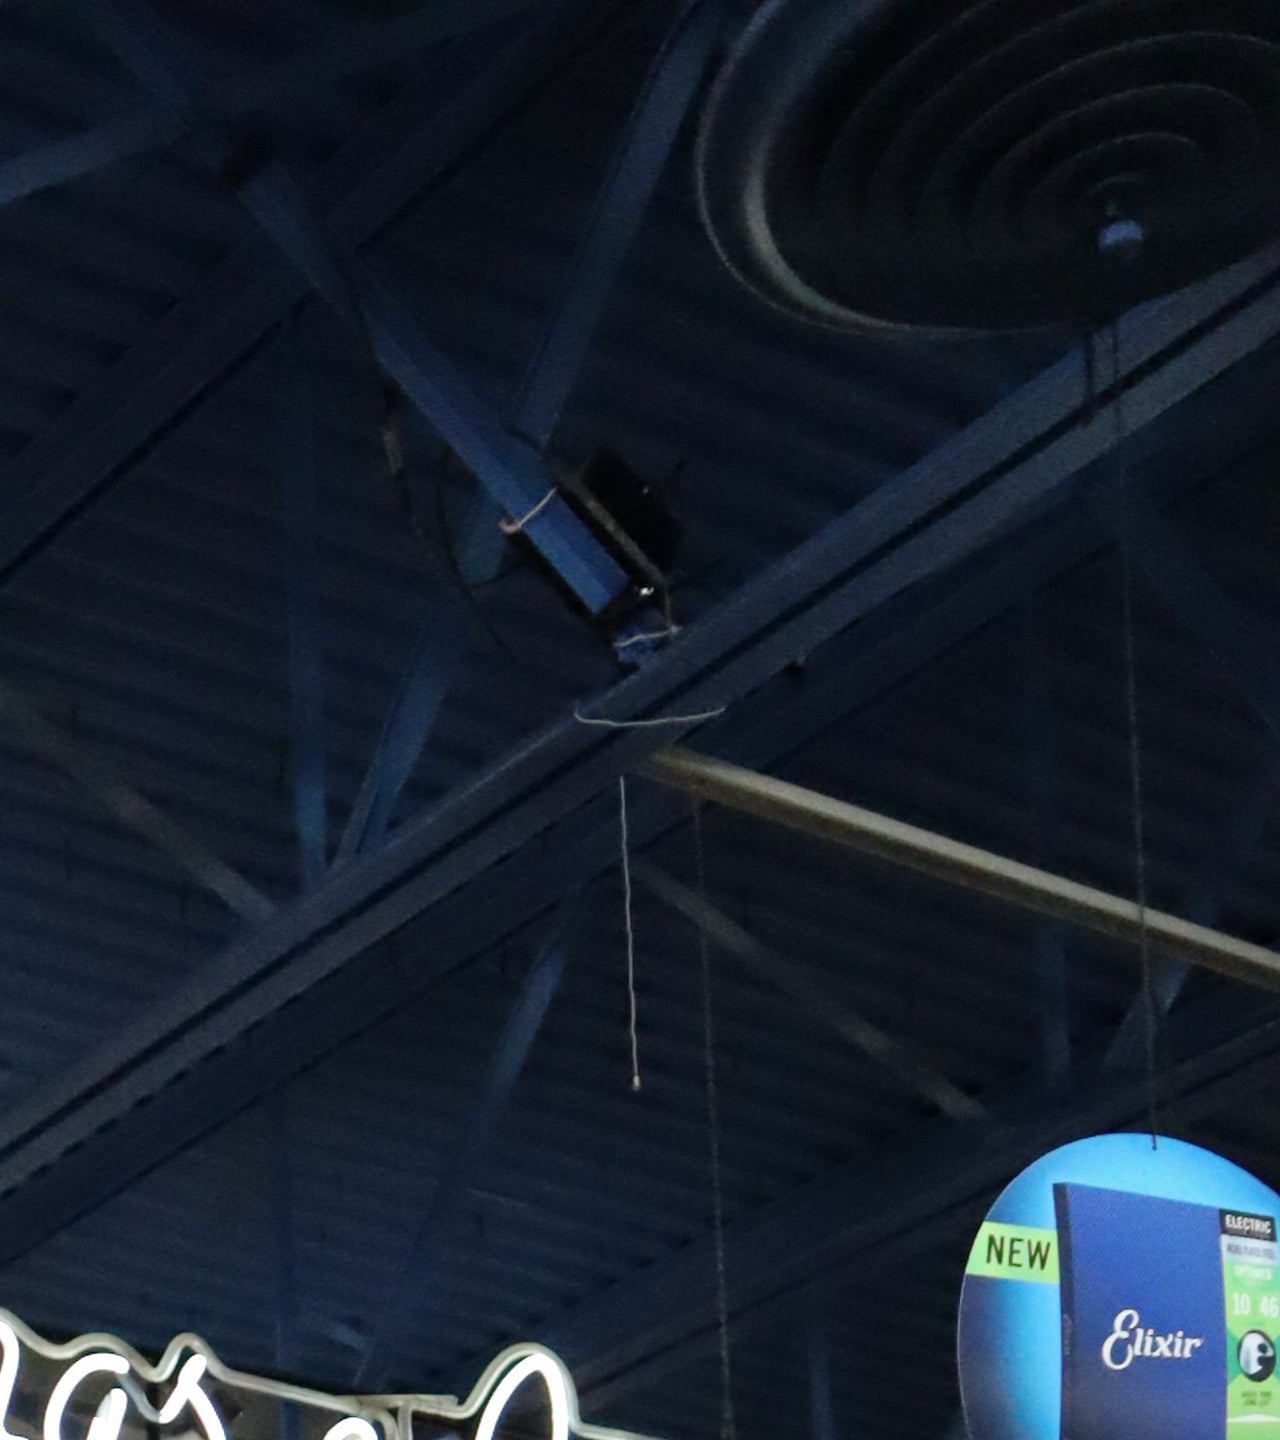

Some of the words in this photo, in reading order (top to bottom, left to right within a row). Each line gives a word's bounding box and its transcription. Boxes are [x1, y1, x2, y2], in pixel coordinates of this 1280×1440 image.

[1226, 1213, 1271, 1234] ELECTRIC
[986, 1233, 1051, 1271] NEW
[1101, 1308, 1204, 1371] Elixir
